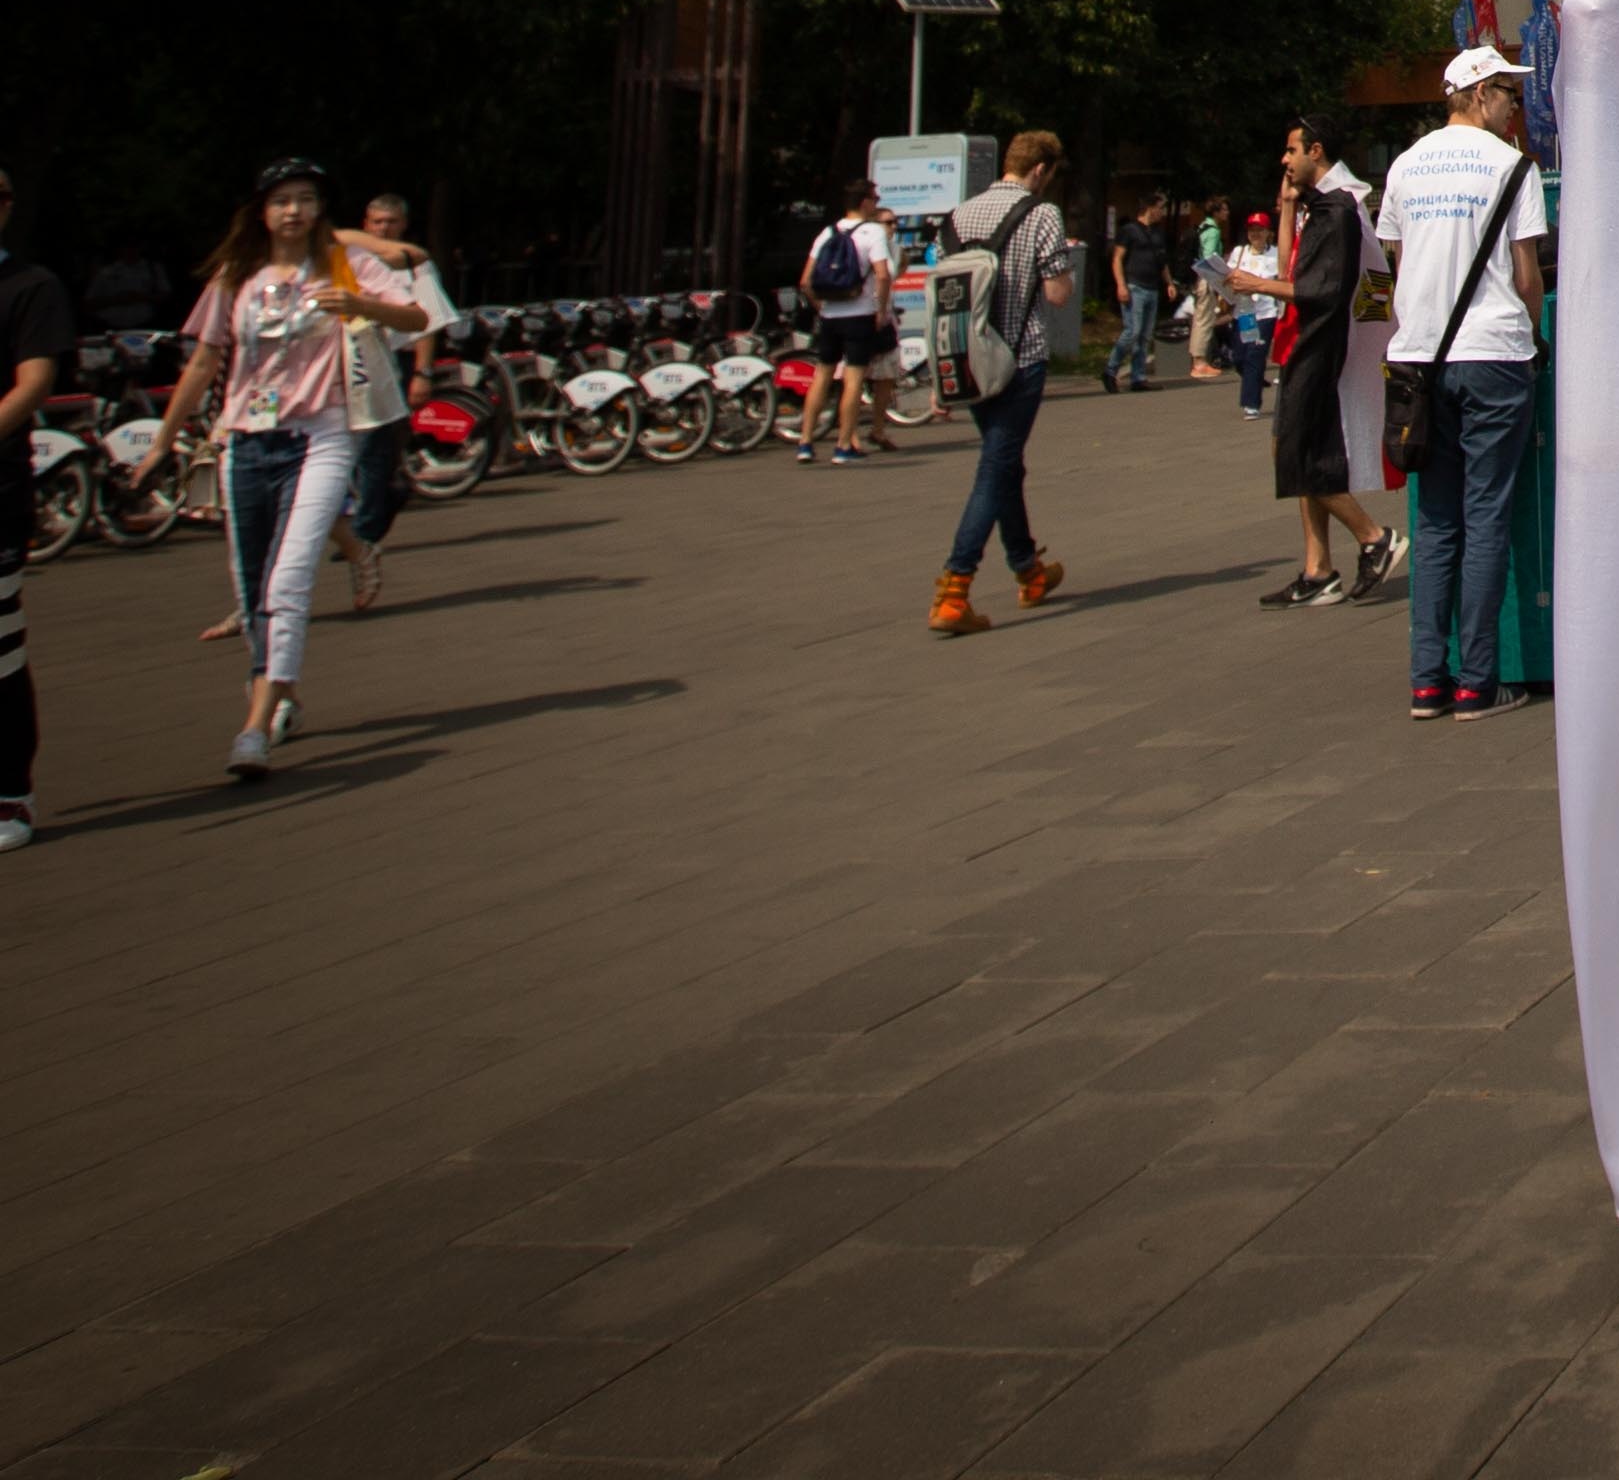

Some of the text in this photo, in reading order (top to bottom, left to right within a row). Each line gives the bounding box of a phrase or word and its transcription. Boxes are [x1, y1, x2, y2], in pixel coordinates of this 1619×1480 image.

[1418, 148, 1482, 162] OFFICIAL
[1402, 162, 1498, 179] PROGRAMME
[1402, 193, 1489, 210] ОФИЦИАЛЬНАЯ
